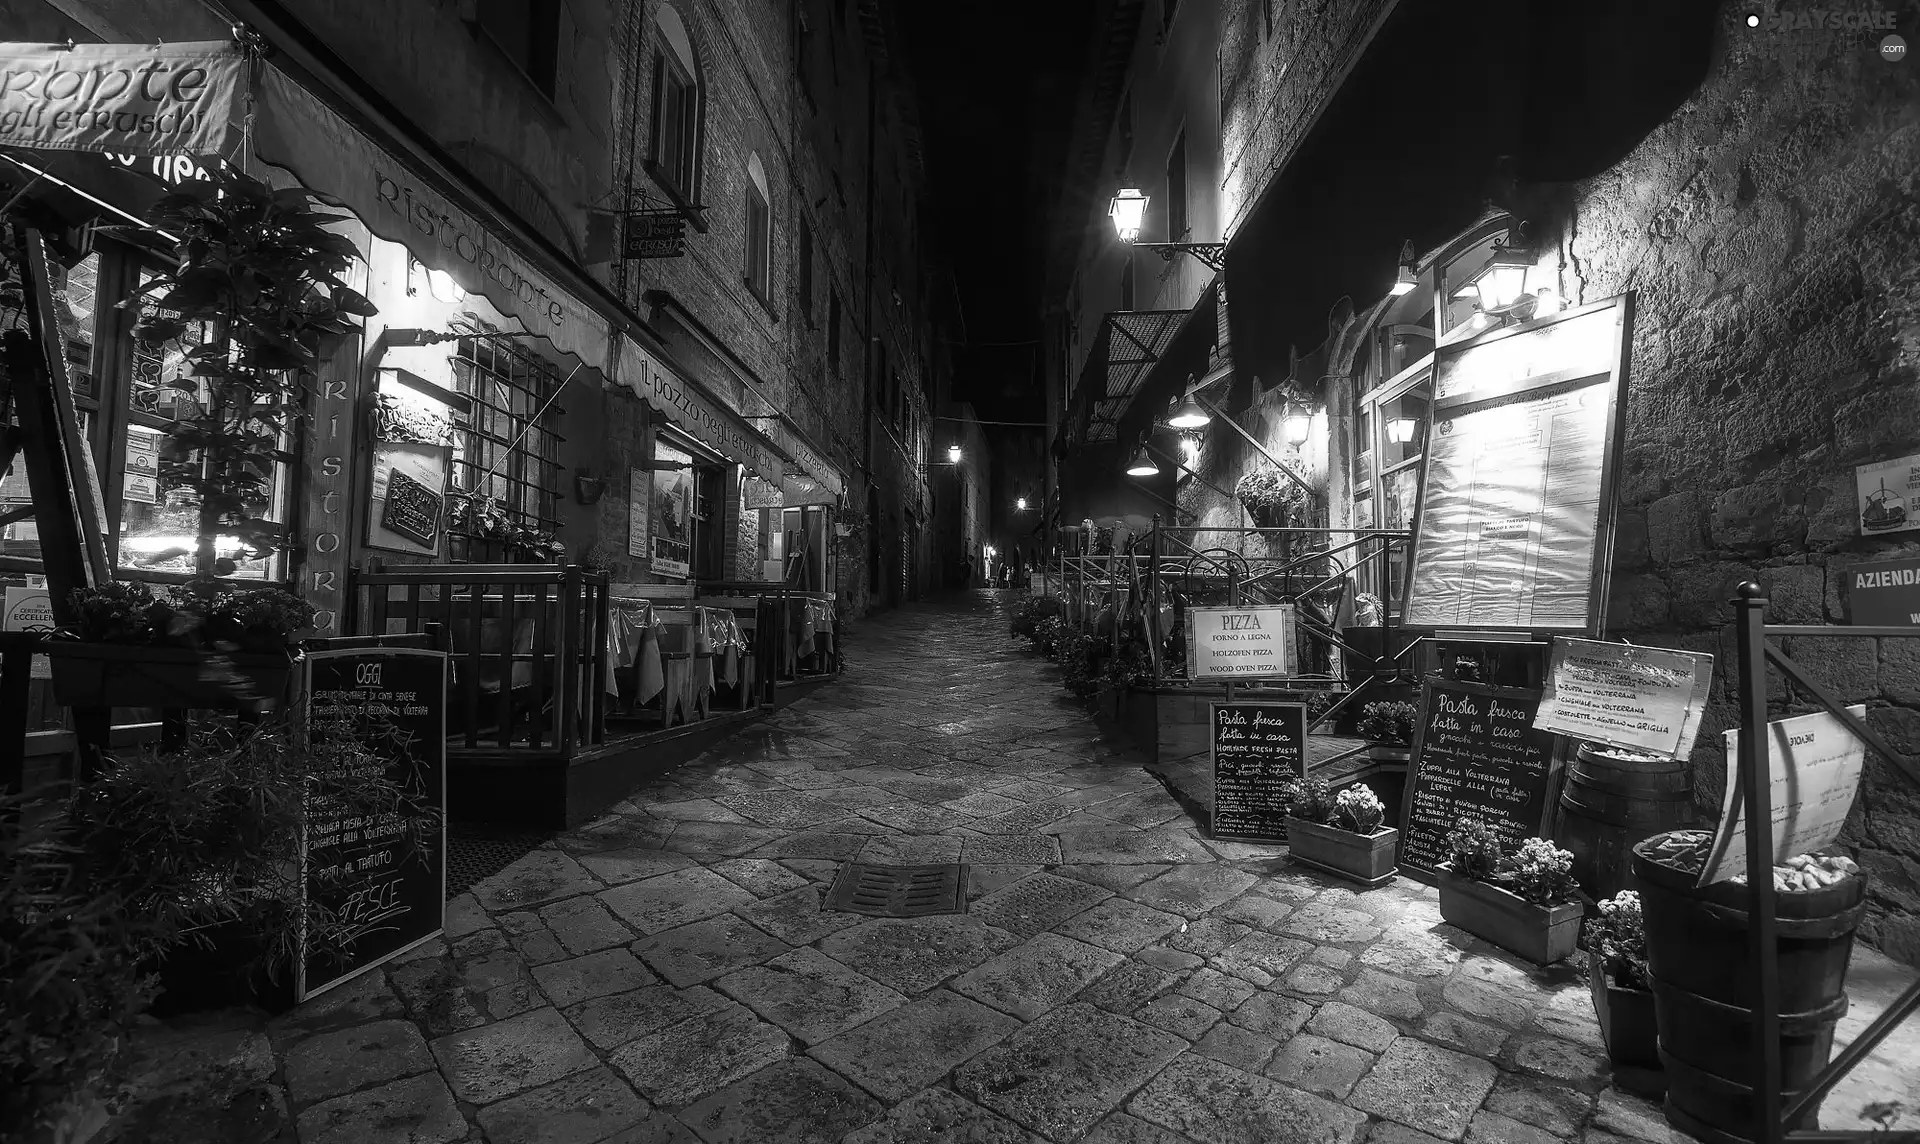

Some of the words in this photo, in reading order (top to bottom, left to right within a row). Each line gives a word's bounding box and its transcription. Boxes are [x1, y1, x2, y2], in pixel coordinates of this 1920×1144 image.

[653, 373, 699, 421] pozzo
[1222, 614, 1262, 631] PIZZA
[1212, 634, 1238, 642] FORNO
[1247, 633, 1272, 641] LEGNA
[1212, 650, 1250, 658] HOLZOFEN
[1253, 649, 1273, 657] PIZZA
[356, 663, 382, 685] OGGI
[1209, 665, 1233, 673] WOOD
[1236, 664, 1256, 672] OVEN
[1637, 679, 1672, 689] FONDUTA
[1593, 689, 1637, 700] VOLTERRANA
[1438, 693, 1479, 717] Pasta
[1487, 699, 1529, 725] fresca
[1601, 702, 1645, 714] VOLTERRANA
[1218, 709, 1248, 725] Pasta
[1252, 710, 1286, 730] fresca
[1431, 714, 1462, 733] fatta
[1470, 721, 1485, 735] in
[1492, 725, 1524, 740] casa
[1557, 709, 1591, 720] COSTOLETTE
[1596, 716, 1627, 726] AGNELLO
[1636, 722, 1669, 734] GRIGLIA
[1219, 726, 1246, 743] fatta
[1249, 732, 1262, 740] in
[1265, 734, 1292, 742] casa
[1275, 747, 1298, 755] PASTA
[1420, 761, 1443, 774] ZUPPA
[1465, 768, 1511, 786] VOLTERRANA
[1466, 781, 1486, 792] ALLA
[1418, 791, 1445, 803] RISOTTO
[1479, 804, 1511, 817] PORCINI
[1453, 806, 1485, 820] RICOTTA
[1415, 814, 1453, 829] TAGLIATELLE
[1410, 830, 1437, 842] FILETTO
[338, 878, 405, 923] PESCE
